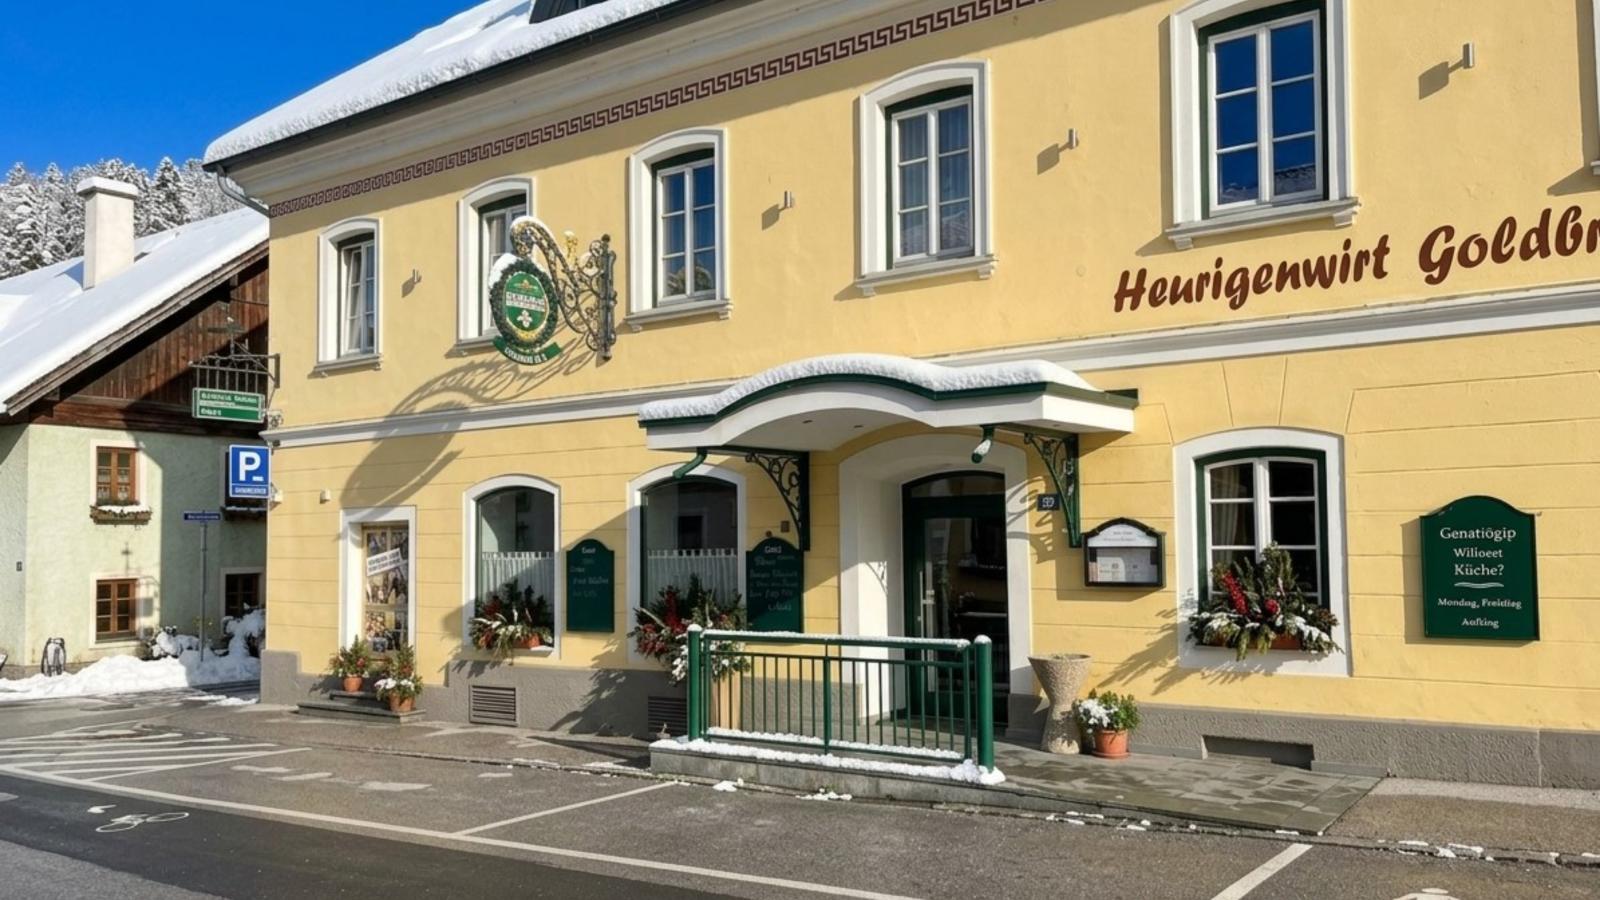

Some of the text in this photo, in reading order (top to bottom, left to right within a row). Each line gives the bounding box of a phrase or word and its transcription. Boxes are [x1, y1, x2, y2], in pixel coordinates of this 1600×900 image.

[1114, 235, 1390, 312] Heurigenwirt
[239, 451, 261, 481] P
[1454, 563, 1505, 576] Küche?
